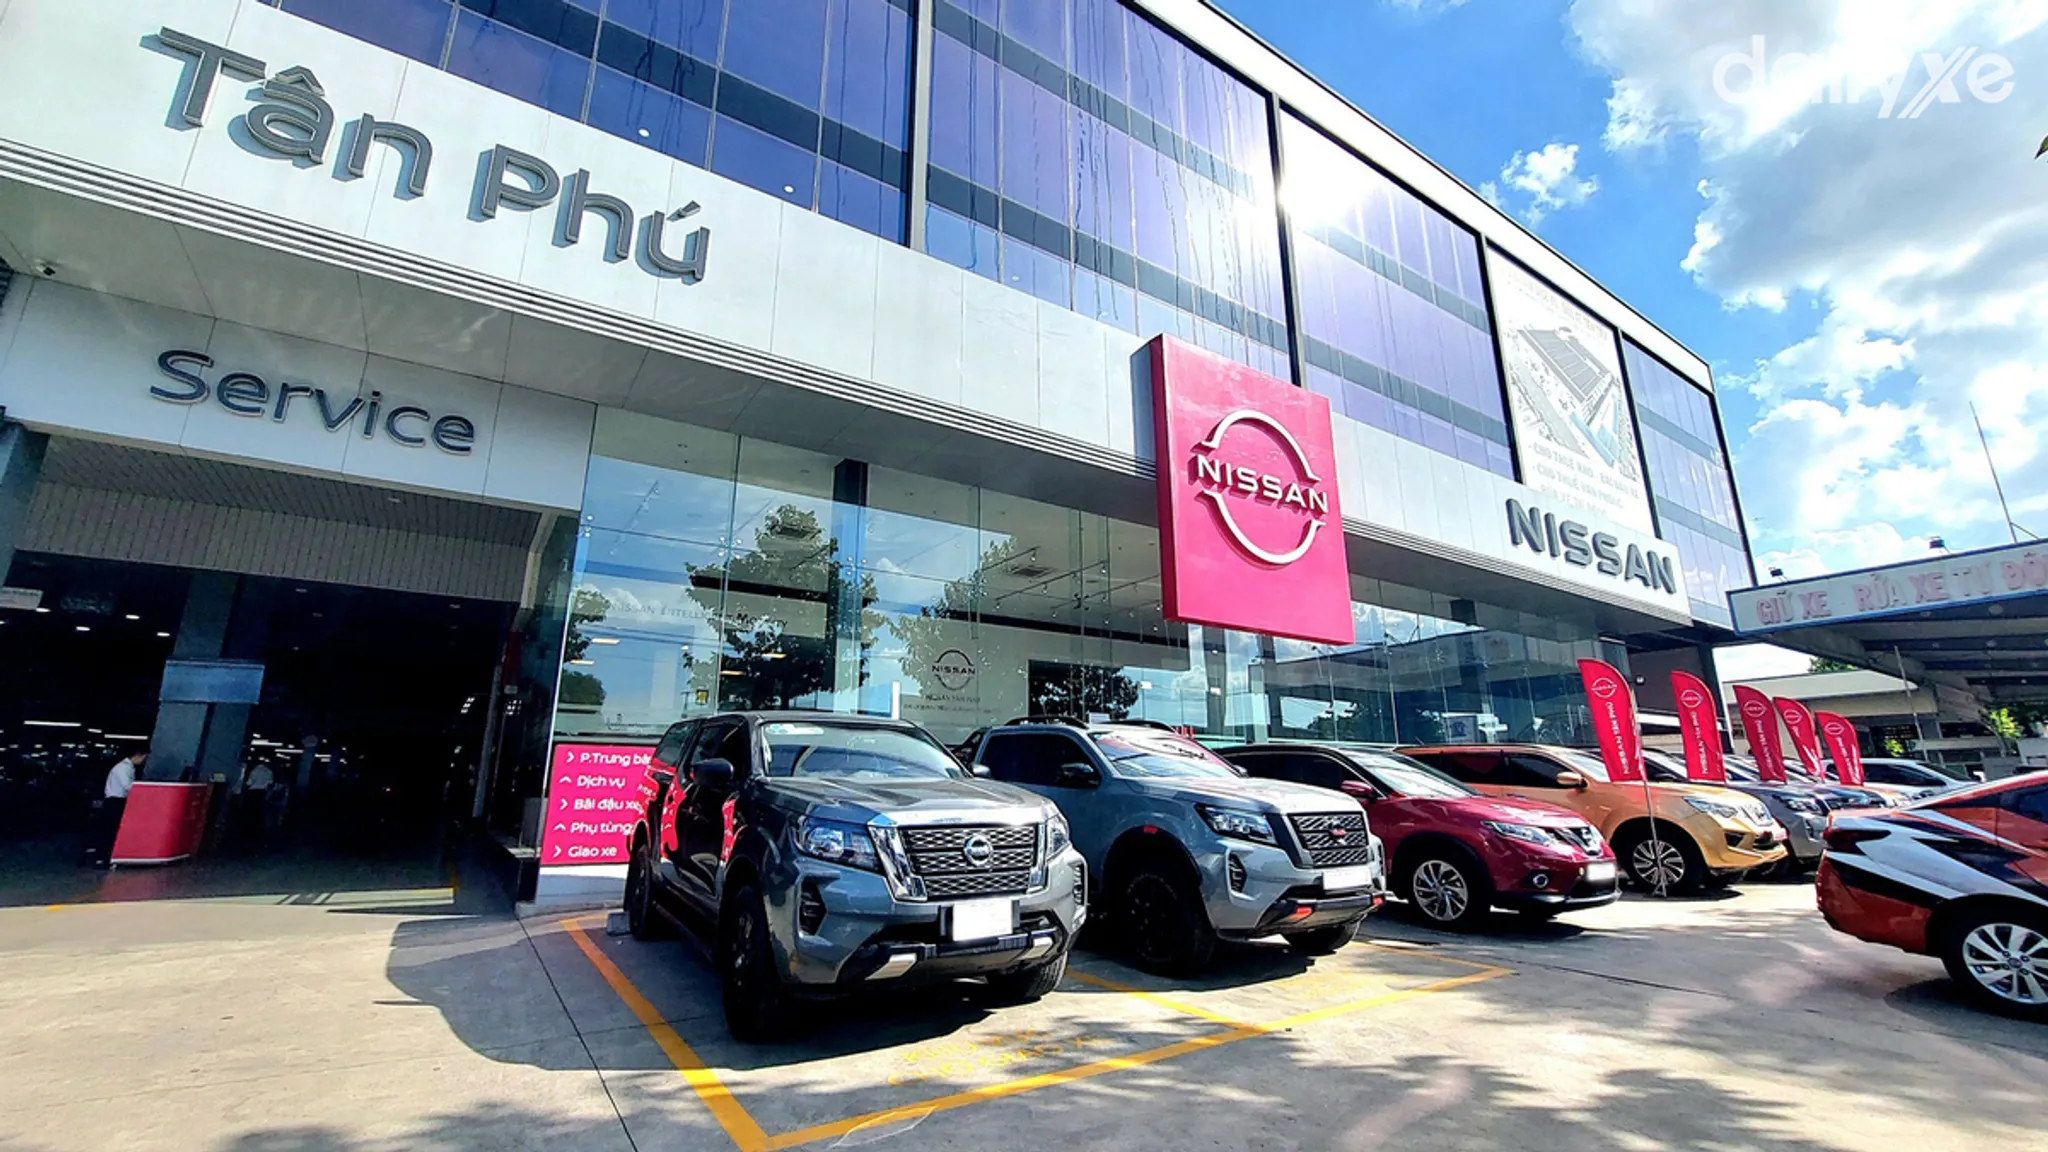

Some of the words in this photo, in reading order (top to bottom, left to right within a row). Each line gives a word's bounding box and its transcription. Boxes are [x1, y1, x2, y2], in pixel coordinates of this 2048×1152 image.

[157, 26, 433, 197] Tân
[479, 144, 711, 282] Phú
[149, 348, 475, 456] Service
[1195, 453, 1329, 516] NISSAN
[1505, 498, 1677, 594] NISSAN
[1798, 590, 1832, 620] XE
[1908, 571, 1949, 604] XE
[931, 665, 976, 675] NISSAN
[577, 775, 607, 789] Dịch
[609, 777, 626, 789] vụ
[568, 845, 599, 858] Giao
[601, 847, 617, 857] xe
[570, 822, 598, 835] Phụ
